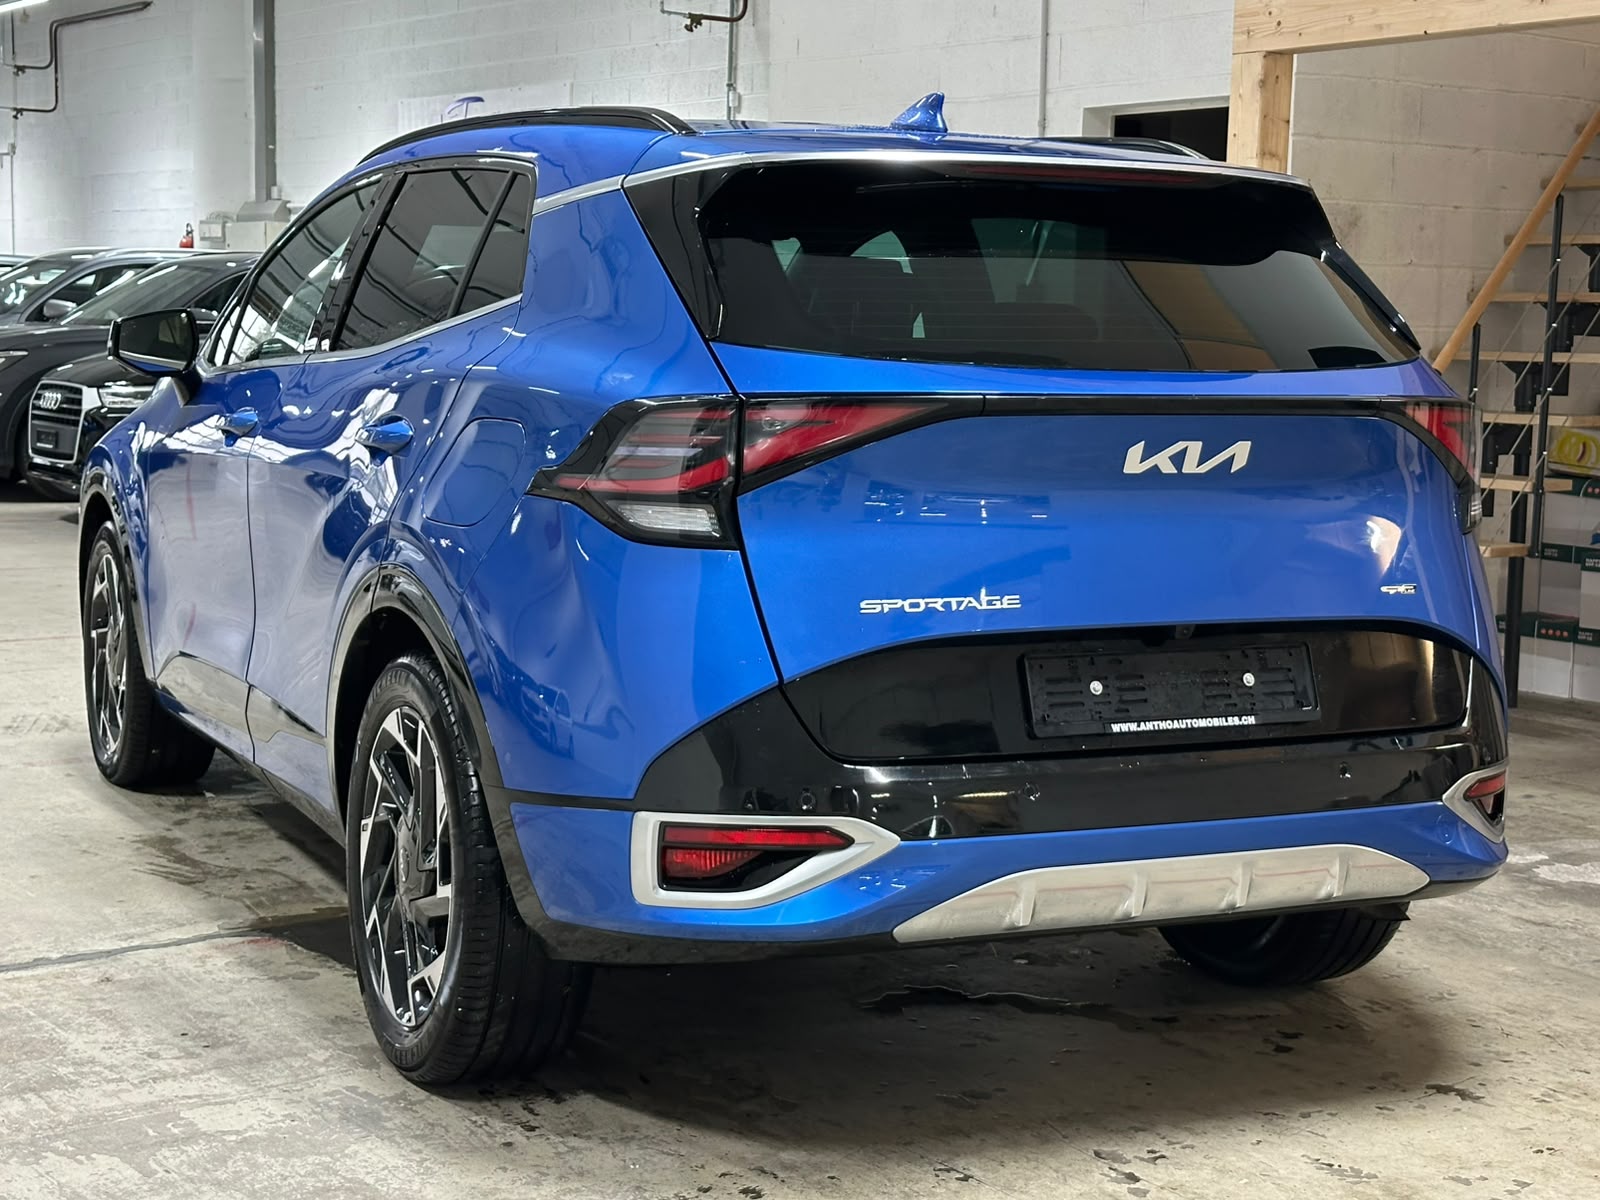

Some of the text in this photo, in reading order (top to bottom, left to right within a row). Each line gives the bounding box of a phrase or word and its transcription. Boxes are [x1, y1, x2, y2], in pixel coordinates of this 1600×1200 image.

[1122, 440, 1252, 474] KIA
[859, 586, 1022, 613] SPORTAGE
[1110, 715, 1256, 733] WWW.ANTHOAUTOMOBILES.CH
